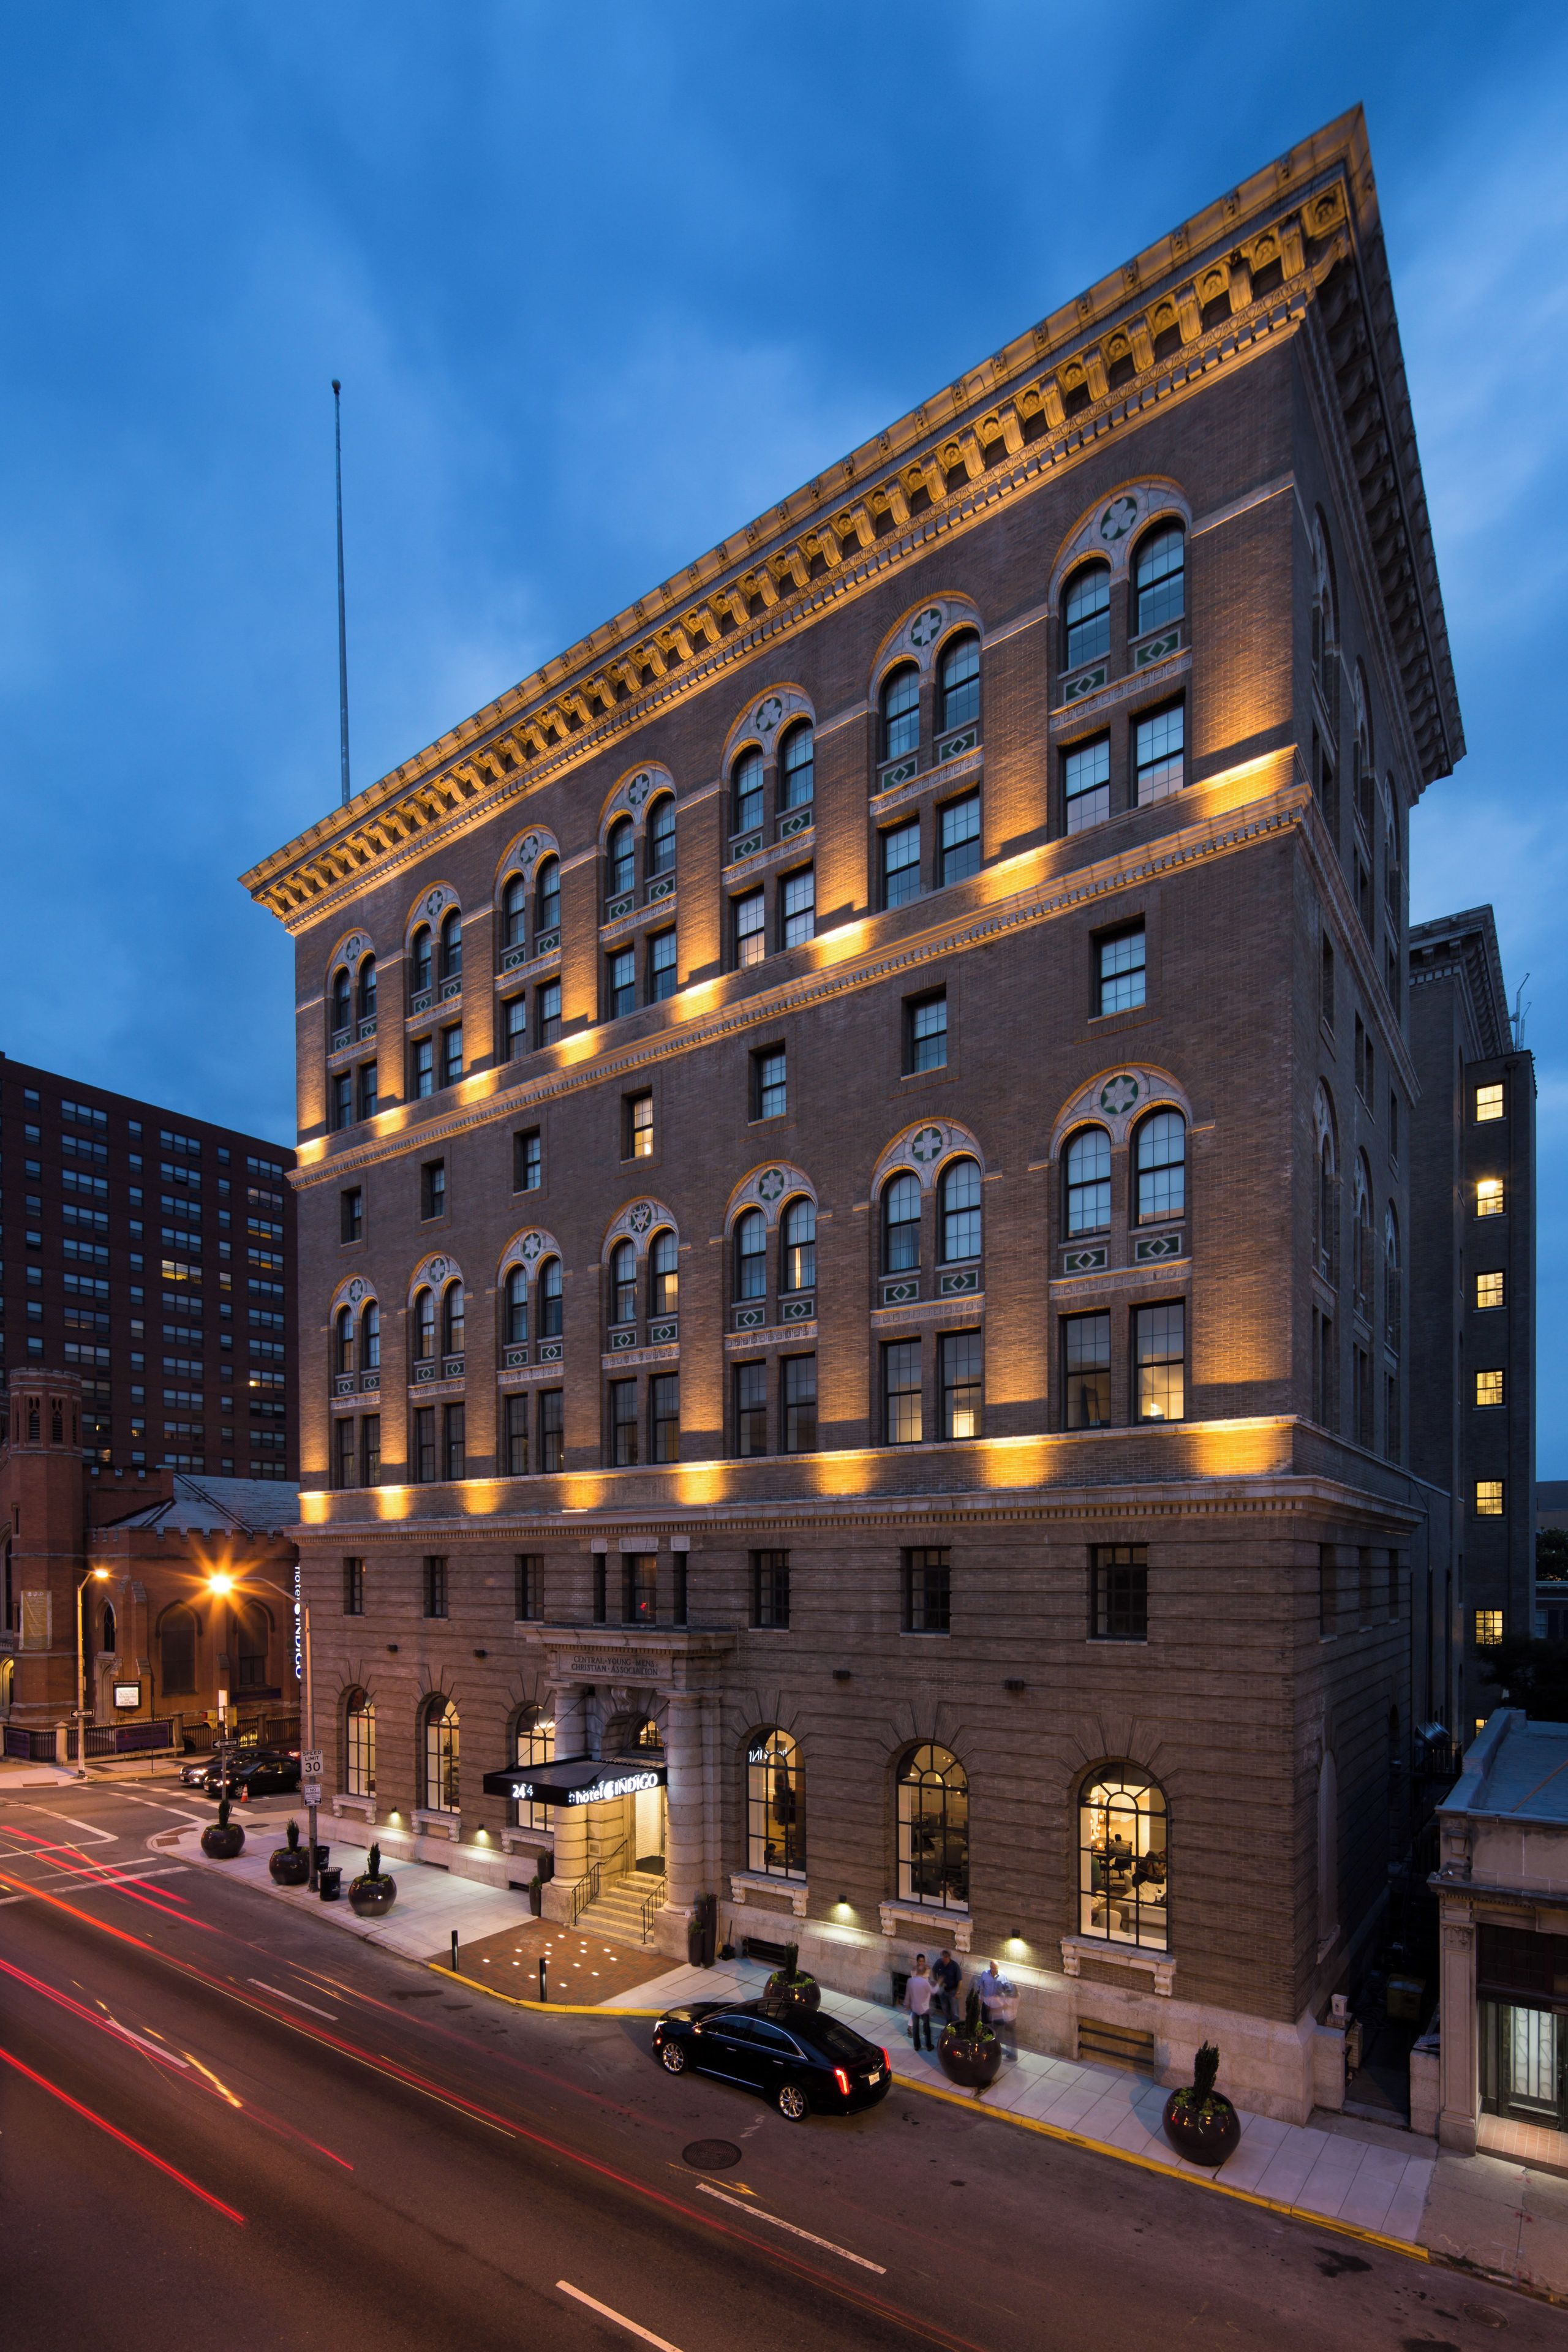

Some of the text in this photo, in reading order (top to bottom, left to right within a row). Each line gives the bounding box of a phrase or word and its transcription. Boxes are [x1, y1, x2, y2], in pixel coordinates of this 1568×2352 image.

[573, 1656, 604, 1664] CENTRAL
[607, 1657, 631, 1665] YOUNG
[571, 1663, 658, 1675] CHRISTIAN ASSOCIATION
[305, 1762, 320, 1773] 30
[576, 1773, 658, 1804] hotel INDIGO
